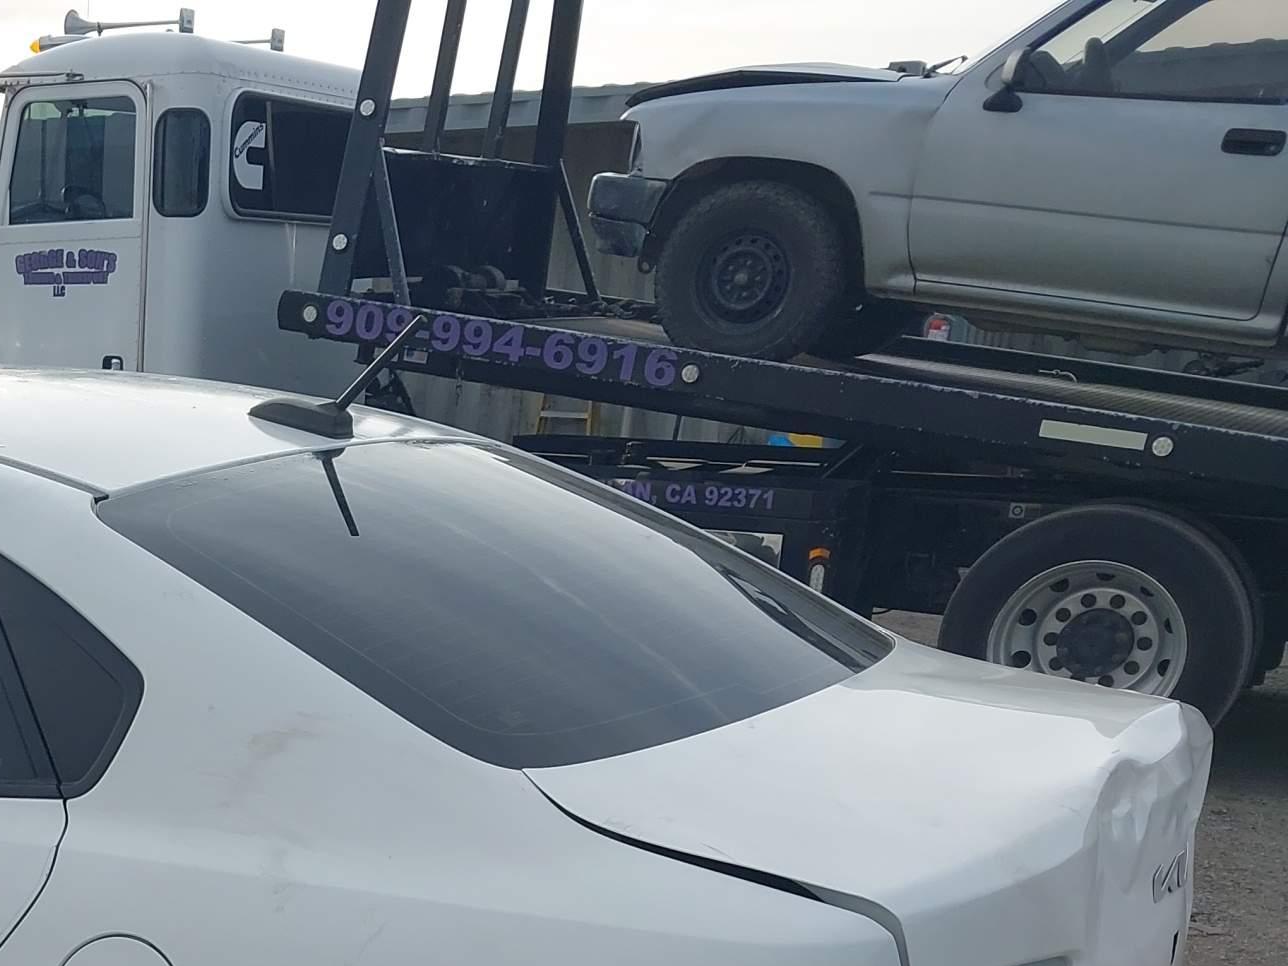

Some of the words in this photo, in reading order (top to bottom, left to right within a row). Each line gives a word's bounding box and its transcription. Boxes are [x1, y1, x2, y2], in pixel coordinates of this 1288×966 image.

[234, 124, 264, 158] Cummins
[66, 250, 77, 268] &
[53, 285, 66, 297] LLC
[325, 300, 678, 387] 909-994-6916
[665, 483, 697, 504] CA
[704, 486, 775, 511] 92371
